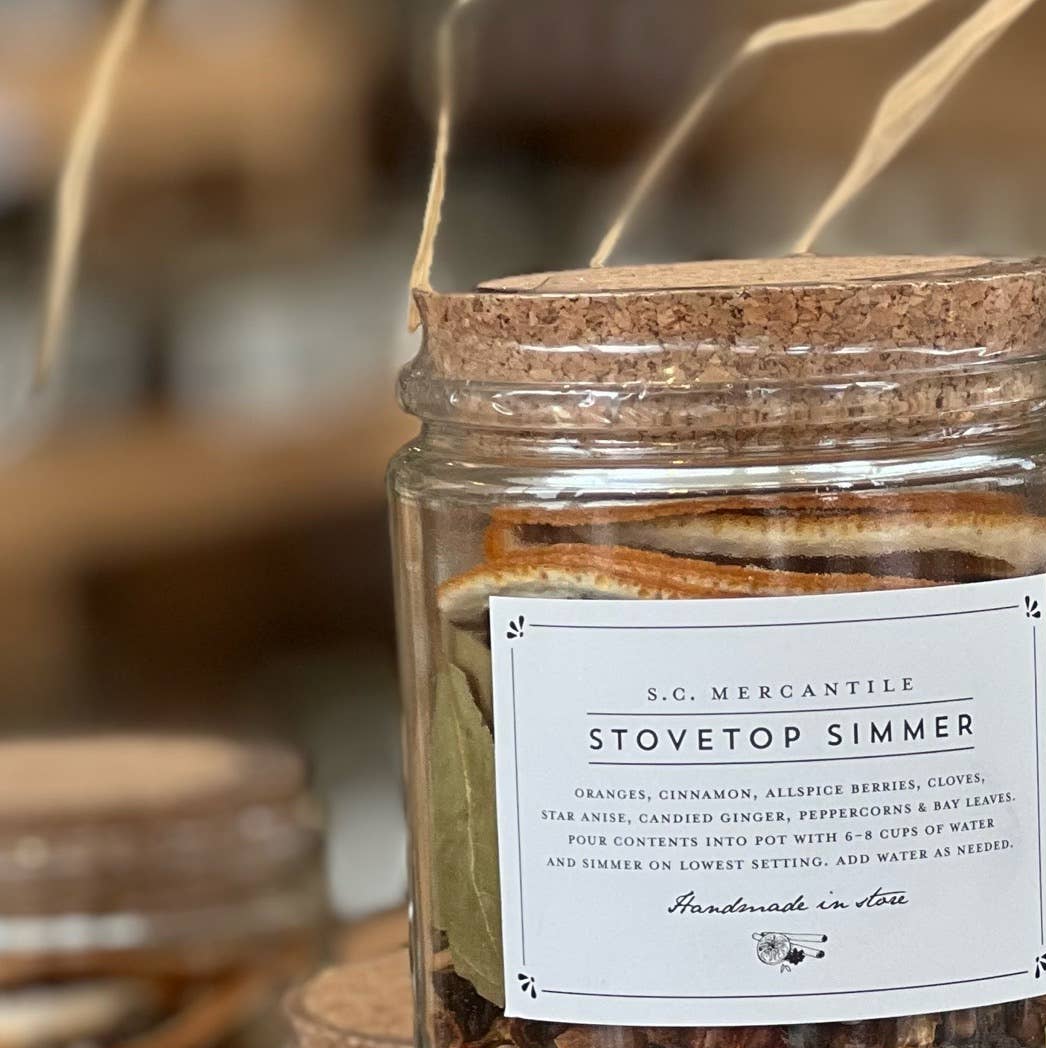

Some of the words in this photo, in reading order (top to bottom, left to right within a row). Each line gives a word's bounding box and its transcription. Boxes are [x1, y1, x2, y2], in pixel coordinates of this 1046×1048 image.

[647, 687, 695, 702] S.C.
[711, 677, 914, 701] MERCANTILE
[589, 725, 801, 752] STOVETOP
[827, 713, 974, 747] SIMMER
[574, 787, 652, 803] ORANGES,
[658, 788, 758, 802] CINNAMON,
[764, 784, 844, 799] ALLSPICE
[850, 779, 921, 795] BERRIES,
[927, 772, 985, 789] CLOVES,
[541, 809, 575, 822] STAR
[580, 811, 632, 826] ANISE,
[638, 812, 714, 824] CANDIED
[719, 811, 791, 825] GINGER,
[798, 802, 912, 821] PEPPERCORNS
[917, 801, 928, 813] &
[933, 798, 961, 812] BAY
[965, 791, 1016, 808] LEAVES.
[568, 834, 608, 847] POUR
[613, 835, 699, 848] CONTENTS
[705, 835, 748, 848] INTO
[754, 834, 788, 846] POT
[792, 832, 838, 845] WITH
[879, 825, 919, 840] CUPS
[924, 823, 945, 836] OF
[948, 817, 995, 833] WATER
[546, 856, 577, 868] AND
[581, 857, 643, 871] SIMMER
[648, 859, 672, 871] ON
[679, 859, 745, 871] LOWEST
[751, 856, 829, 870] SETTING.
[835, 853, 870, 866] ADD
[876, 849, 929, 863] WATER
[933, 846, 951, 859] AS
[956, 839, 1014, 856] NEEDED.
[667, 889, 810, 915] Handmade
[815, 890, 851, 911] in
[854, 886, 910, 909] store
